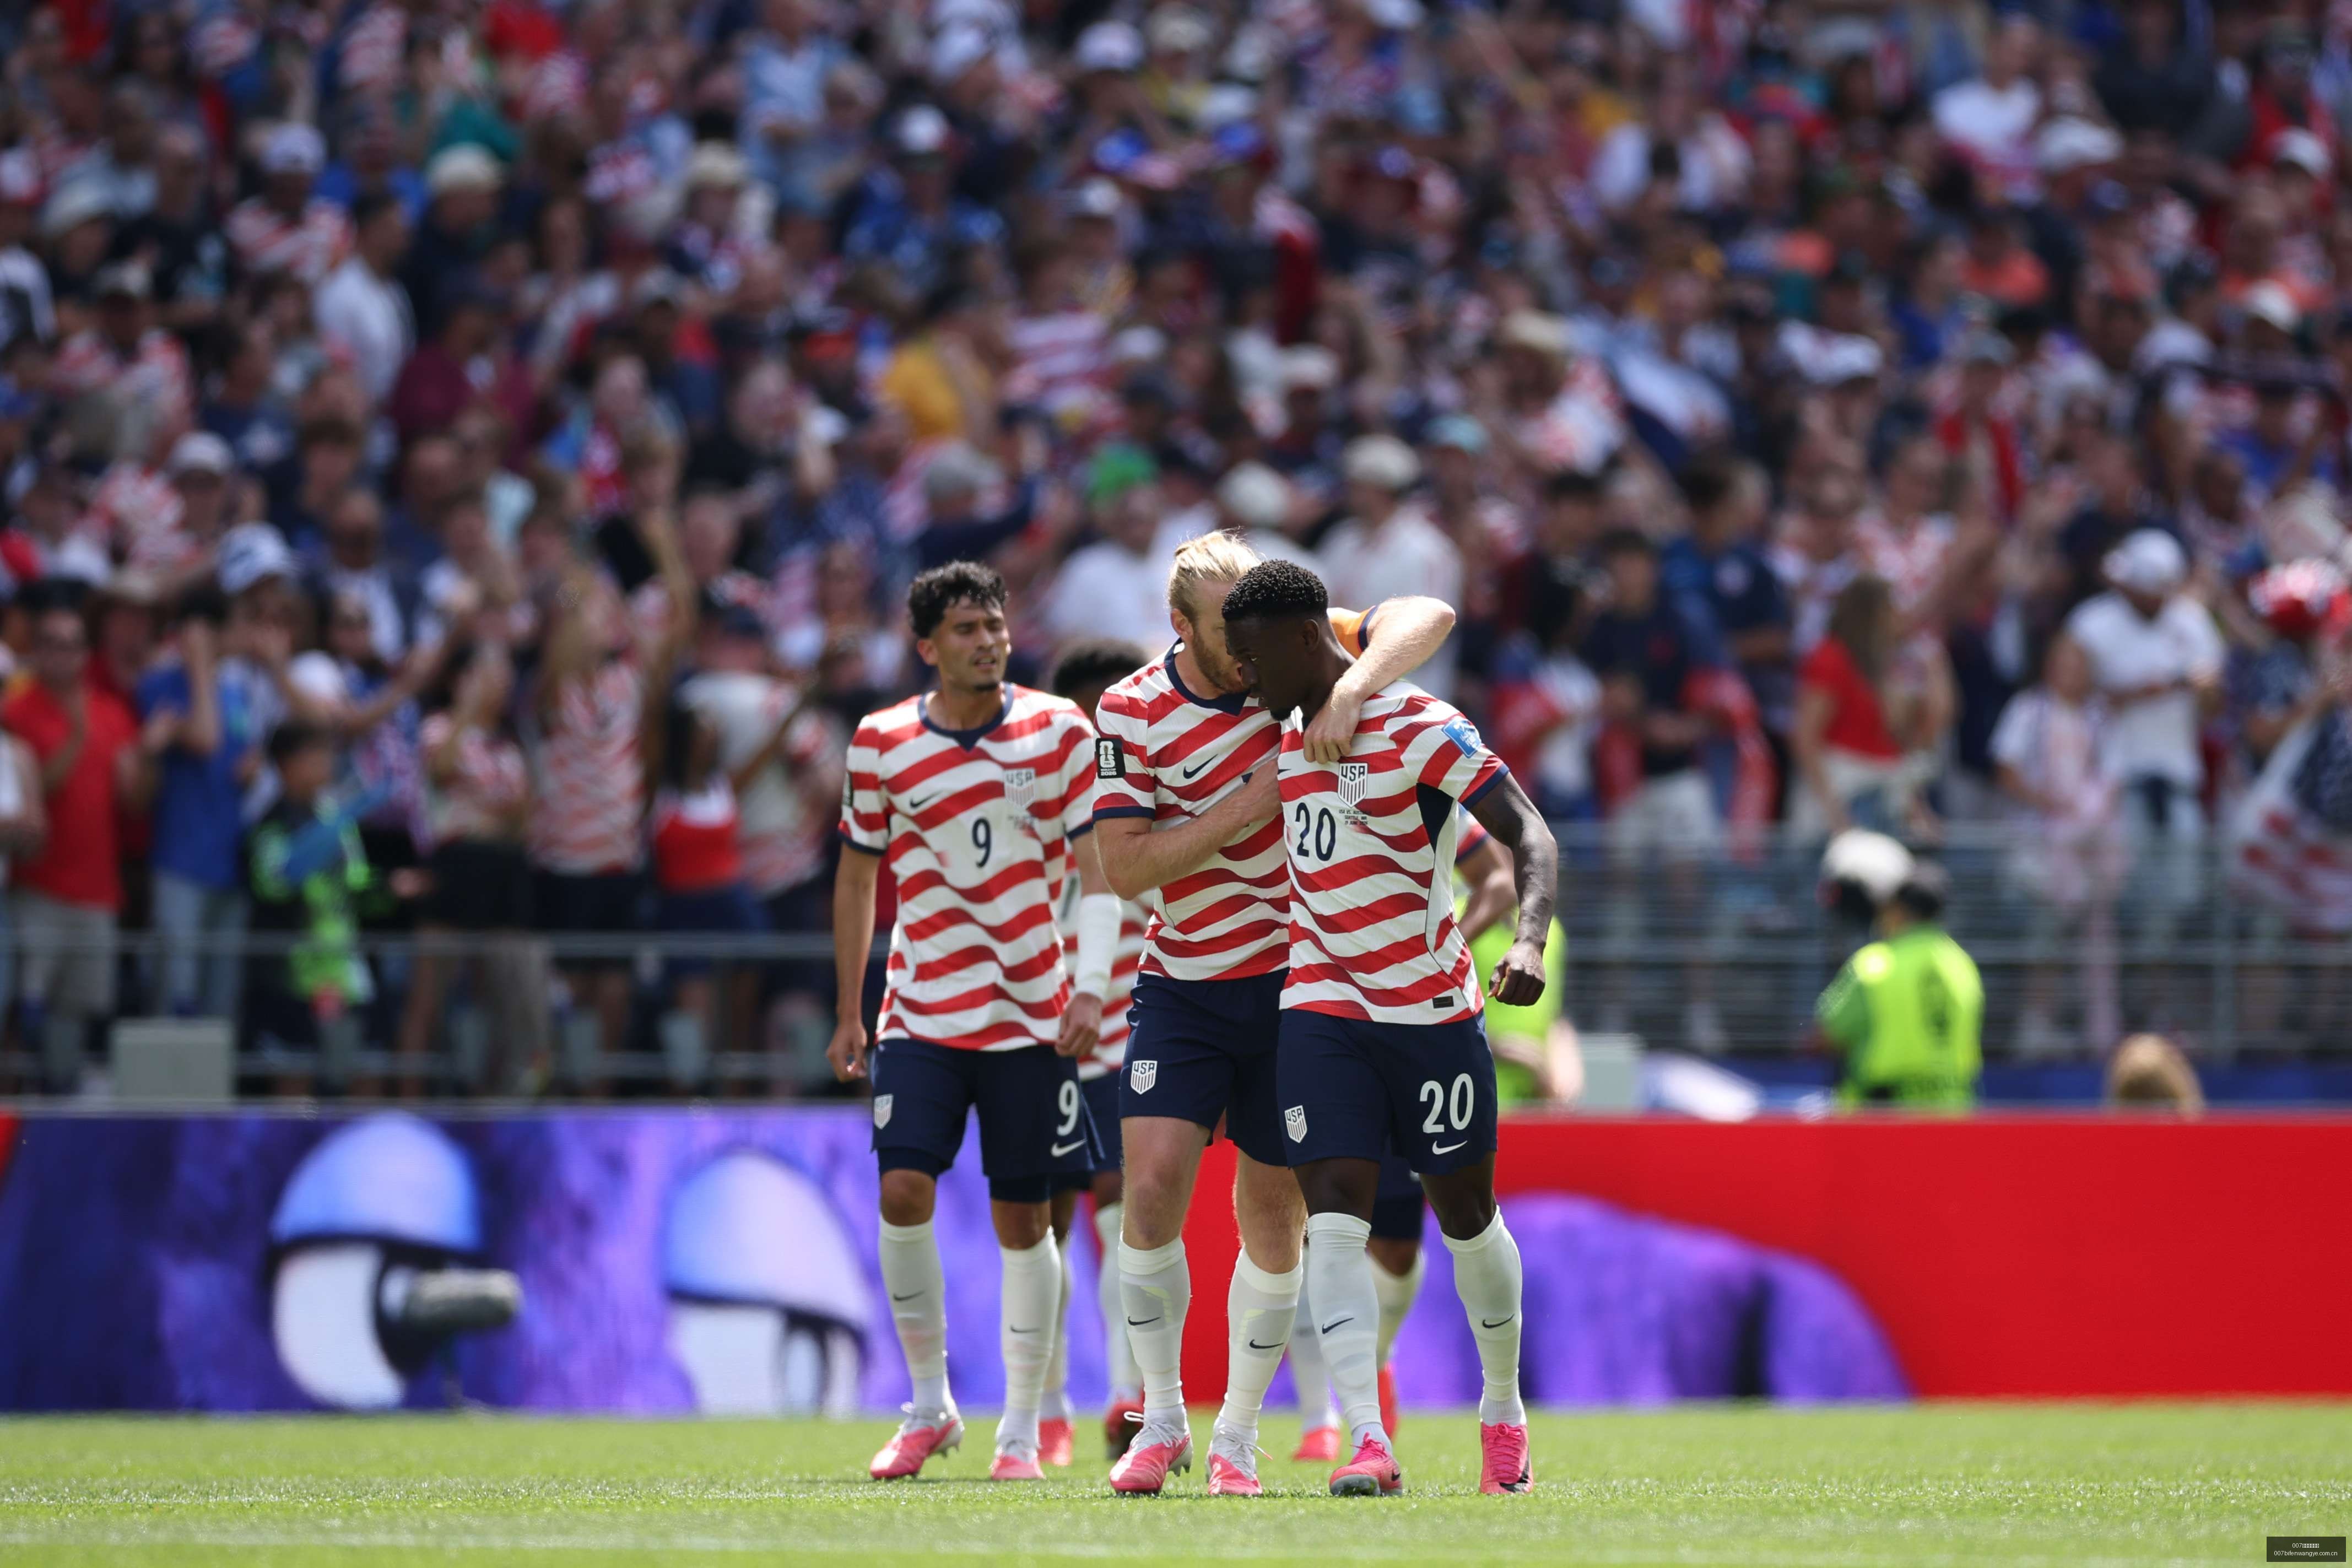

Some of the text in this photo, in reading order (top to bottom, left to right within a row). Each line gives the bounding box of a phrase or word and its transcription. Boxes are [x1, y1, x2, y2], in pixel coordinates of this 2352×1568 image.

[1006, 771, 1032, 787] USA
[1341, 766, 1365, 782] USA
[972, 818, 991, 867] 9
[1295, 802, 1335, 861] 20
[1134, 1062, 1155, 1074] USA
[1057, 1080, 1079, 1136] 9
[1286, 1107, 1302, 1122] USA
[1420, 1073, 1474, 1133] 20
